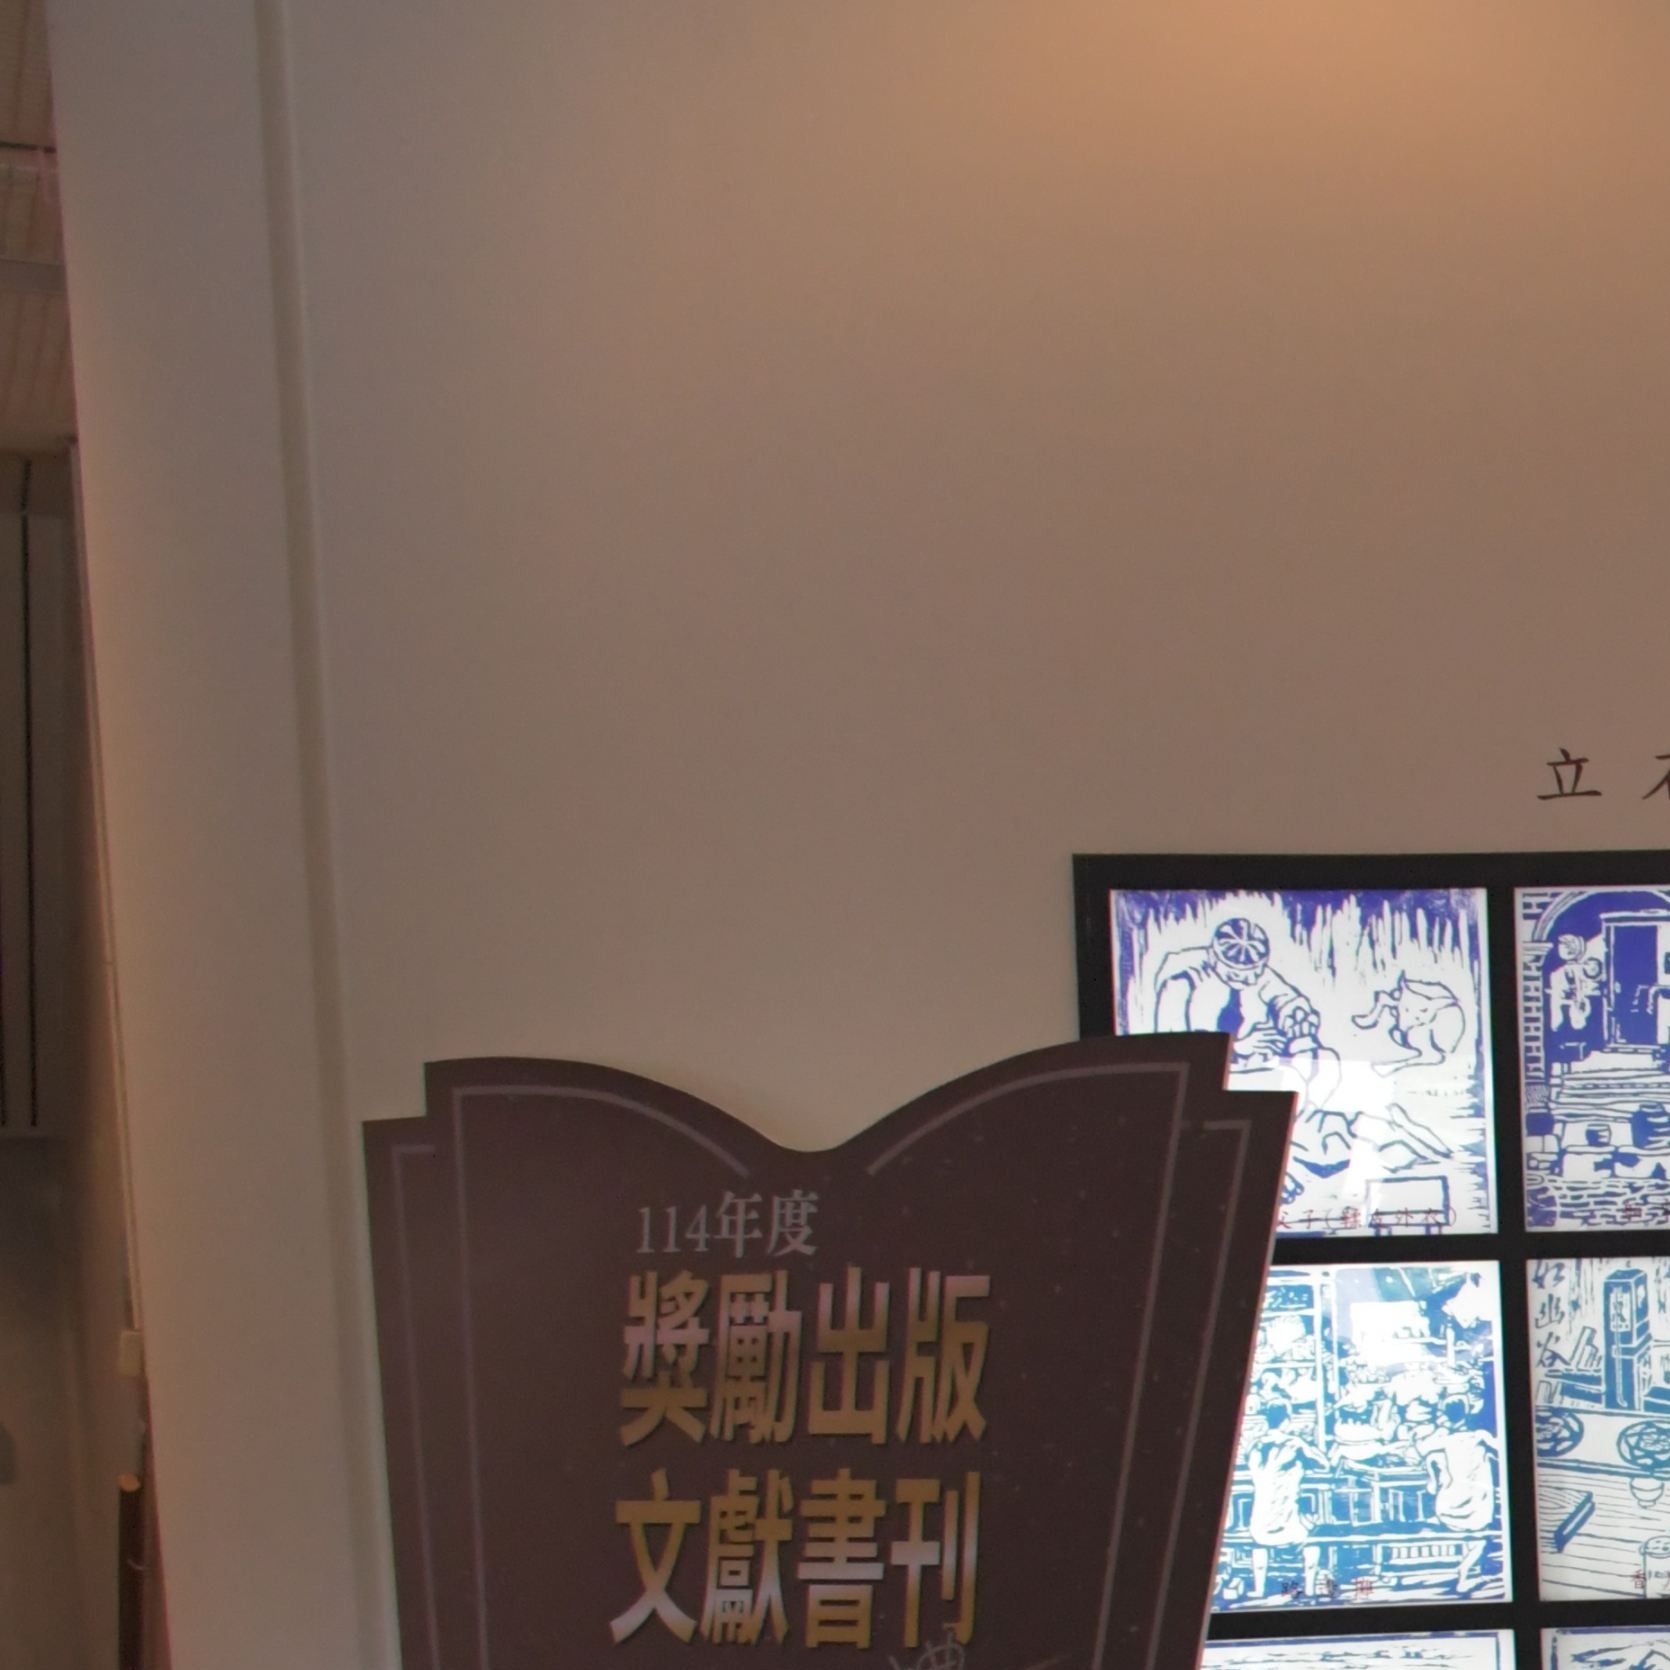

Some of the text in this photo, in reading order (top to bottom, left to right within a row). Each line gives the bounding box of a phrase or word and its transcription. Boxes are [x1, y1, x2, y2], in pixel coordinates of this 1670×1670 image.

[635, 1191, 819, 1259] 114年度
[618, 1267, 992, 1446] 獎勵出版
[610, 1468, 982, 1650] 文獻書刊
